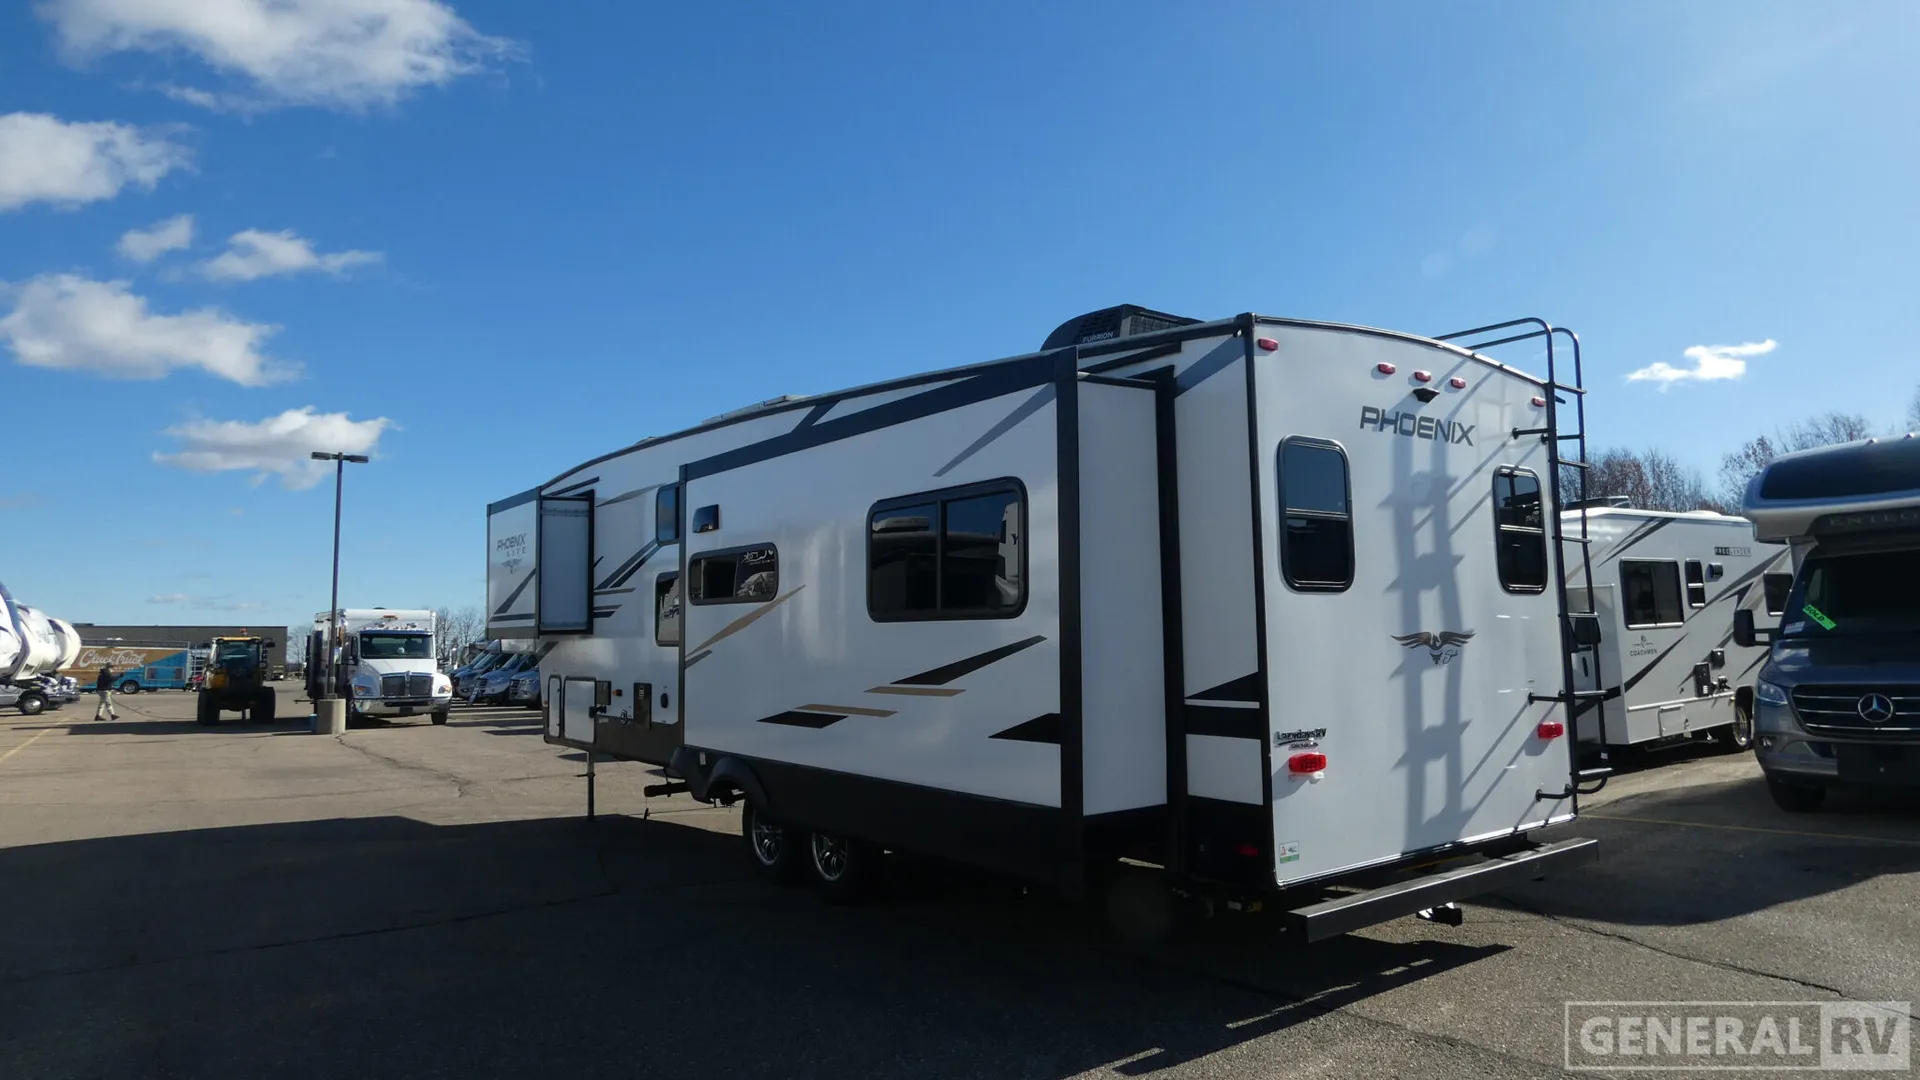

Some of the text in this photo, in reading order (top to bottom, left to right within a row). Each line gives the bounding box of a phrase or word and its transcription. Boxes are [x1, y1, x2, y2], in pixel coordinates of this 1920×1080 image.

[1083, 331, 1113, 343] FURRION
[1360, 406, 1475, 447] PHOENIX
[497, 532, 527, 551] PHOENIX
[507, 546, 527, 557] LITE
[1805, 606, 1825, 622] SOLD
[1629, 648, 1658, 657] COACHMEN
